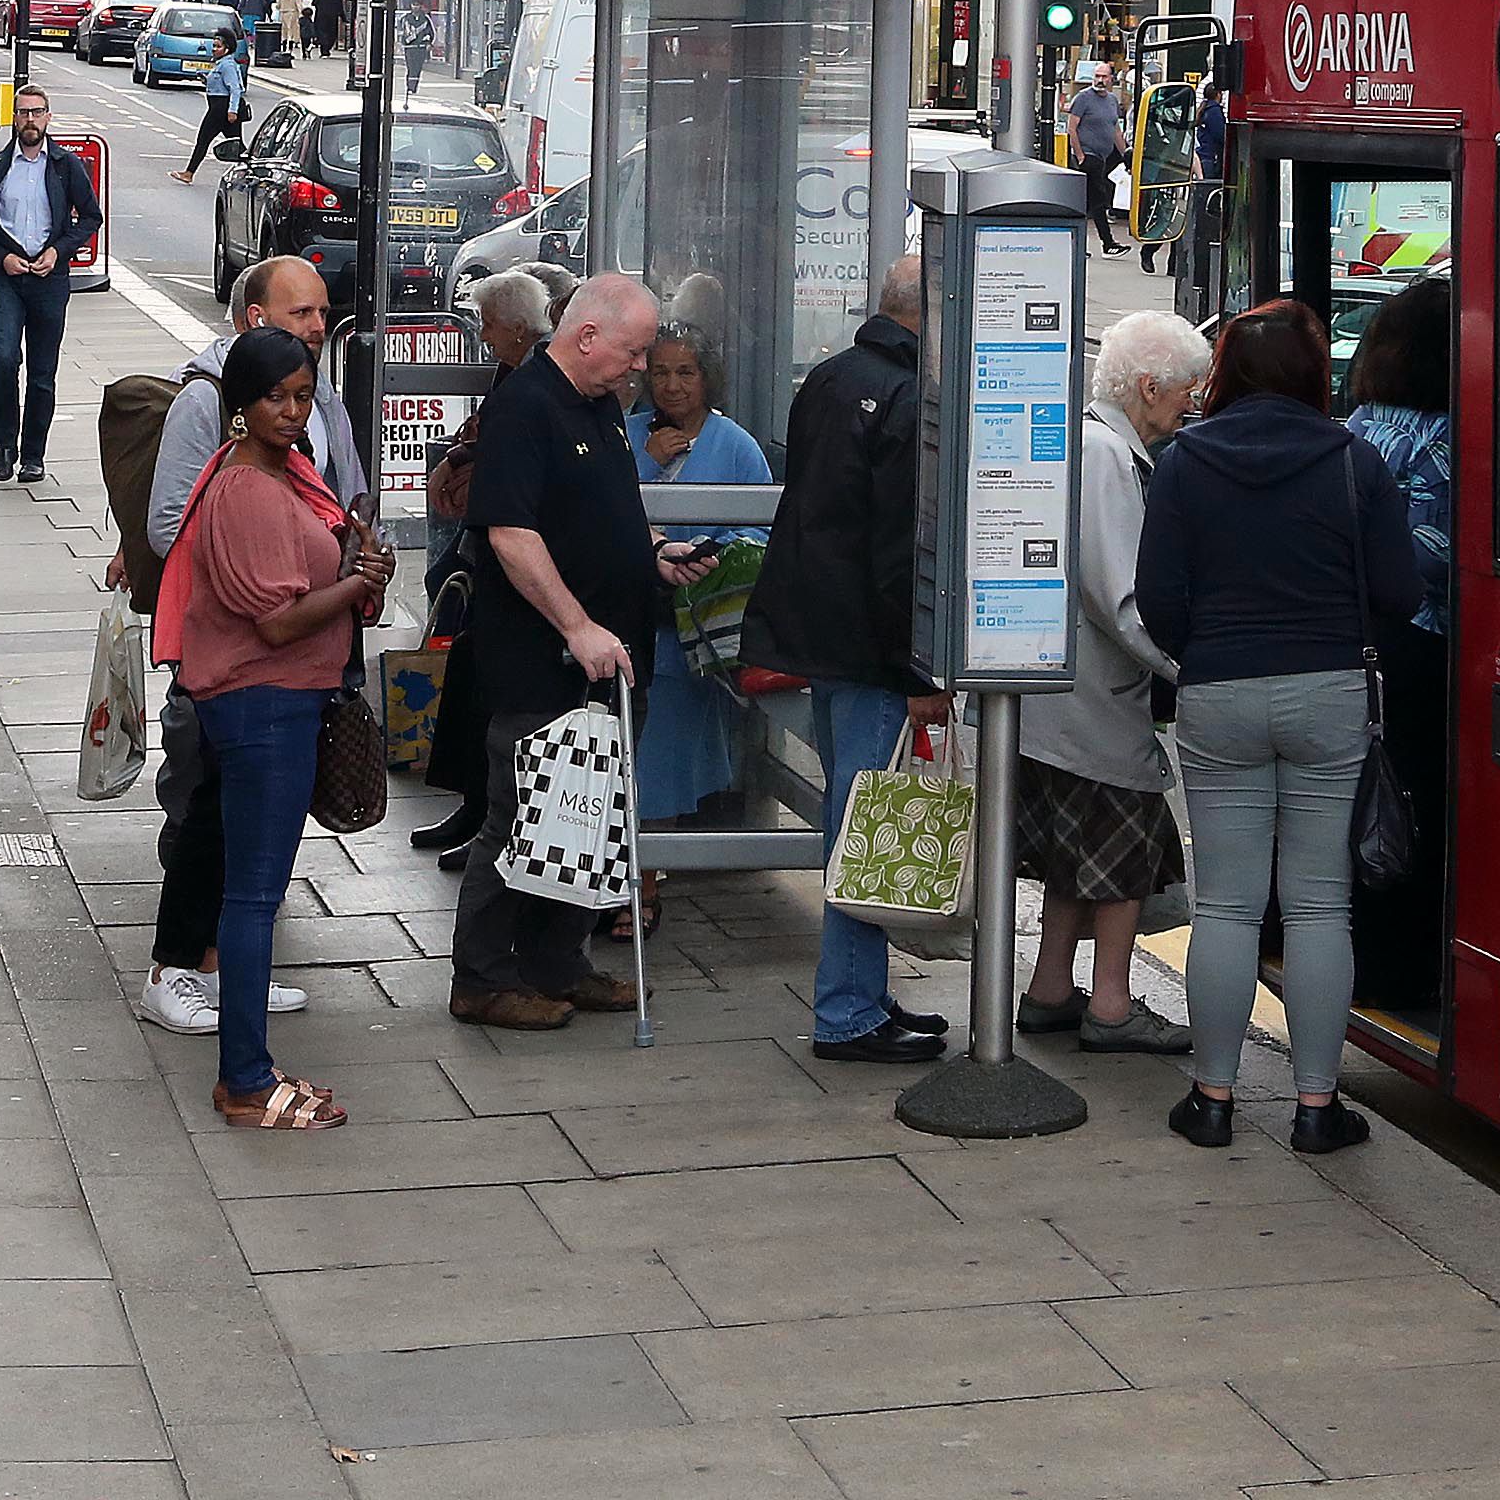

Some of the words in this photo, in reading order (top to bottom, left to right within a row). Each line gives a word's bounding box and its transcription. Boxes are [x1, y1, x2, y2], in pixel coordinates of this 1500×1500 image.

[1315, 12, 1415, 72] ARRIVA
[1345, 83, 1351, 100] a
[1371, 83, 1414, 106] company
[424, 424, 446, 440] TO
[560, 789, 602, 817] M&S
